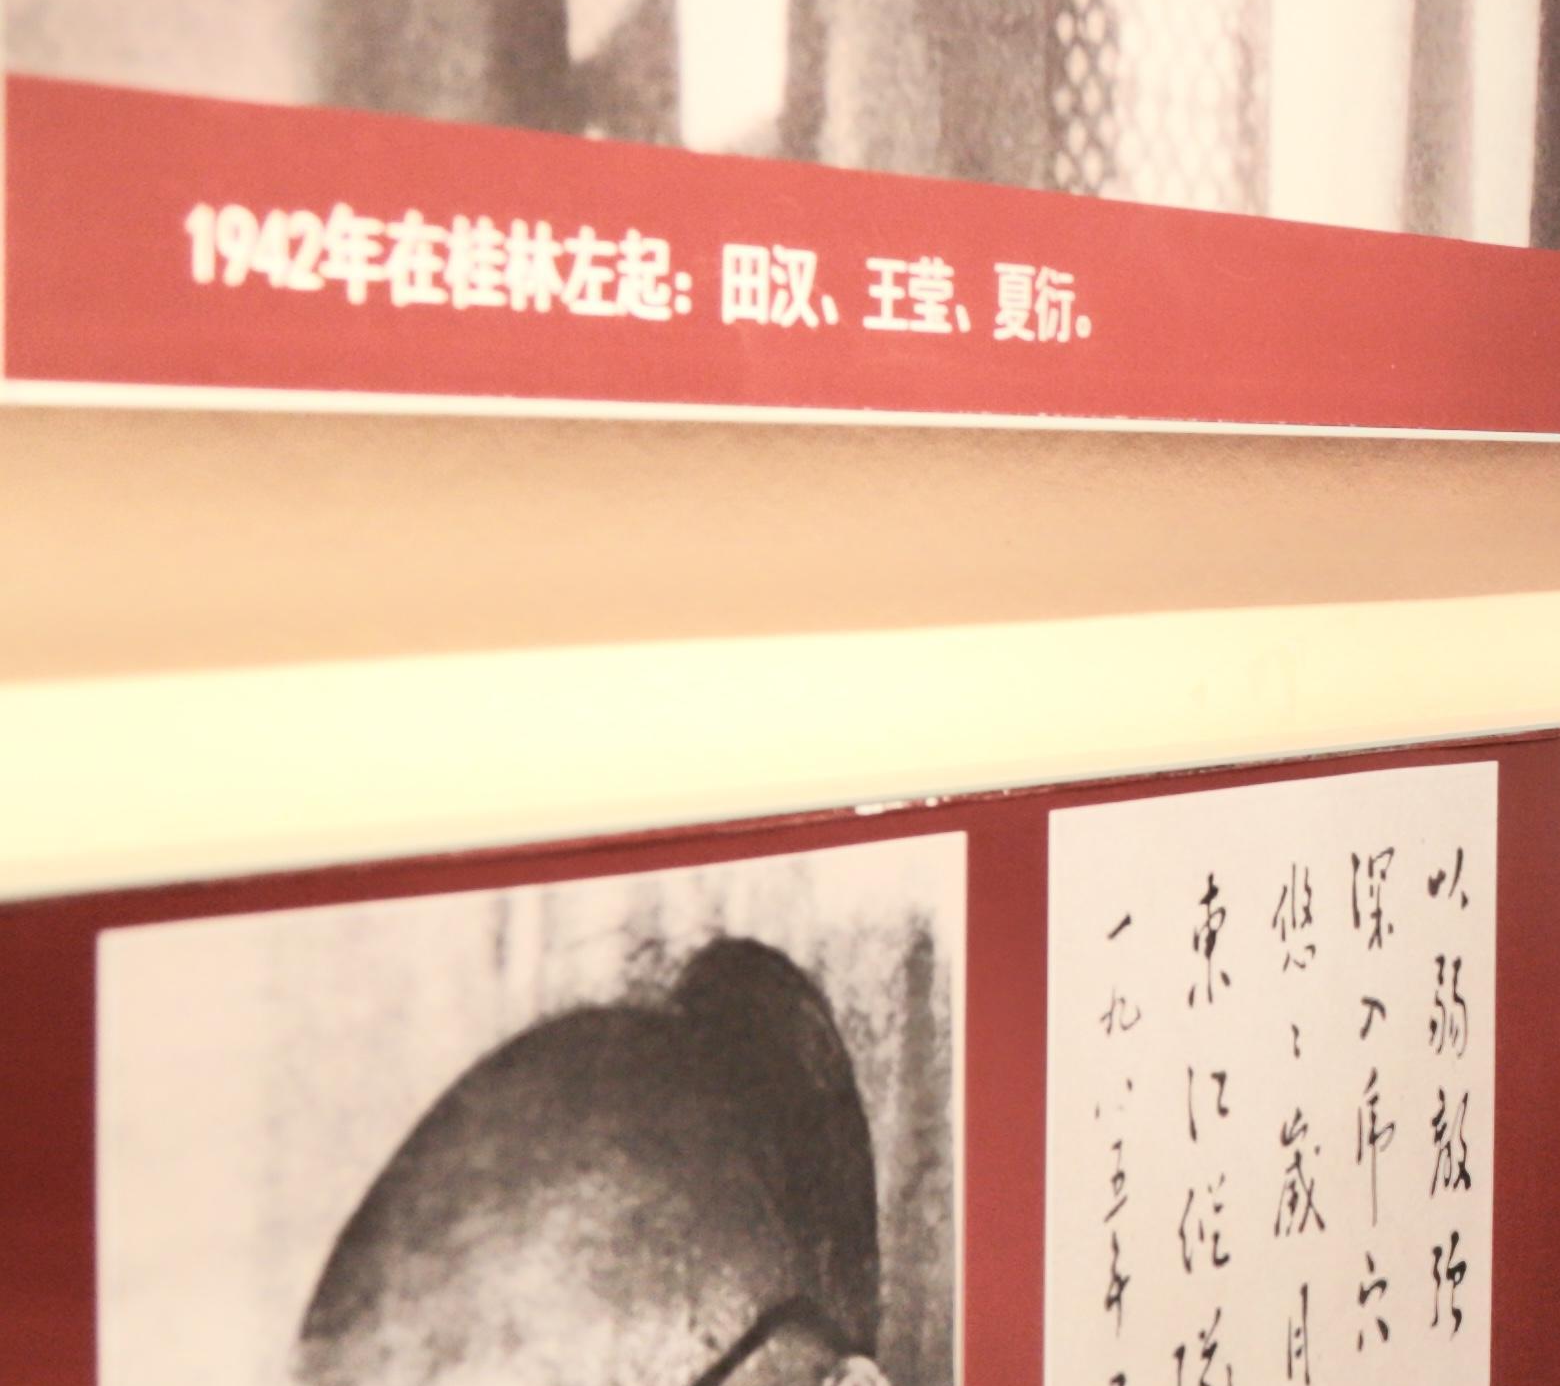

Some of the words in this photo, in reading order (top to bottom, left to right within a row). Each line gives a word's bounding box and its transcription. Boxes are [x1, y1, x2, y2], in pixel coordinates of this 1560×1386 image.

[184, 203, 1093, 343] 1942年在桂林左起：田汉、王莹、夏衍。
